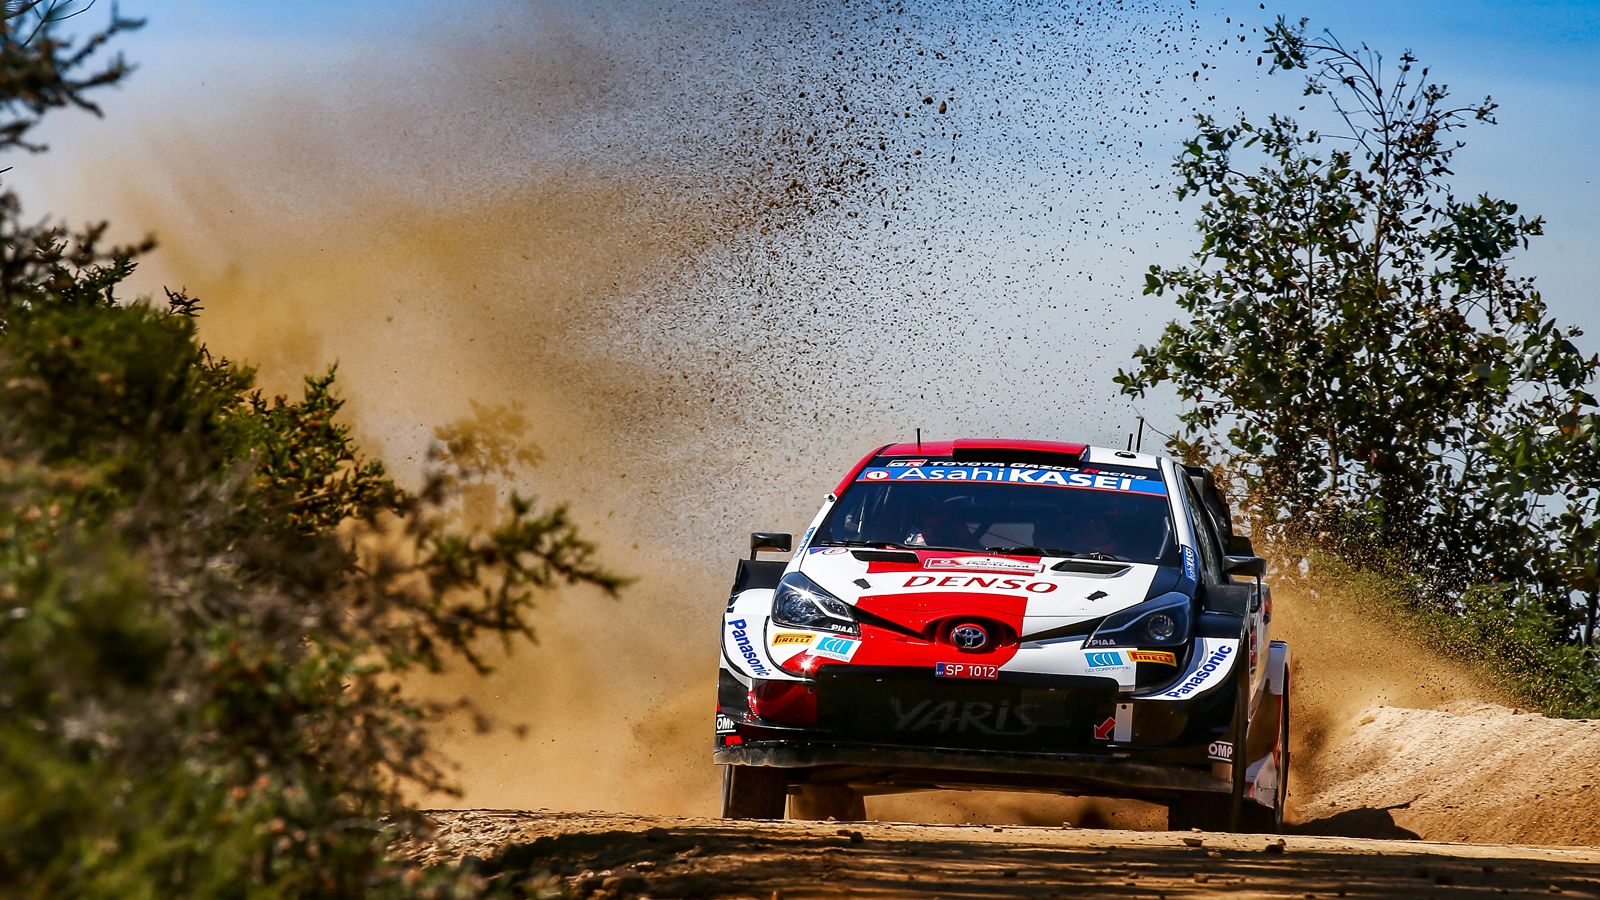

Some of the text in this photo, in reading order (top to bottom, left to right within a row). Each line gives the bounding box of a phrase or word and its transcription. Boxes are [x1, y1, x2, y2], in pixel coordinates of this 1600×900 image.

[1009, 462, 1080, 472] GAZOO
[902, 576, 1058, 594] DENSO
[831, 624, 853, 633] PIAA
[774, 635, 813, 644] PIRELLI
[728, 619, 771, 676] Panasonic
[1131, 652, 1174, 663] PIRELLI
[945, 664, 996, 678] SP 1012
[1165, 645, 1232, 698] Panasonic
[1208, 743, 1233, 758] OMP
